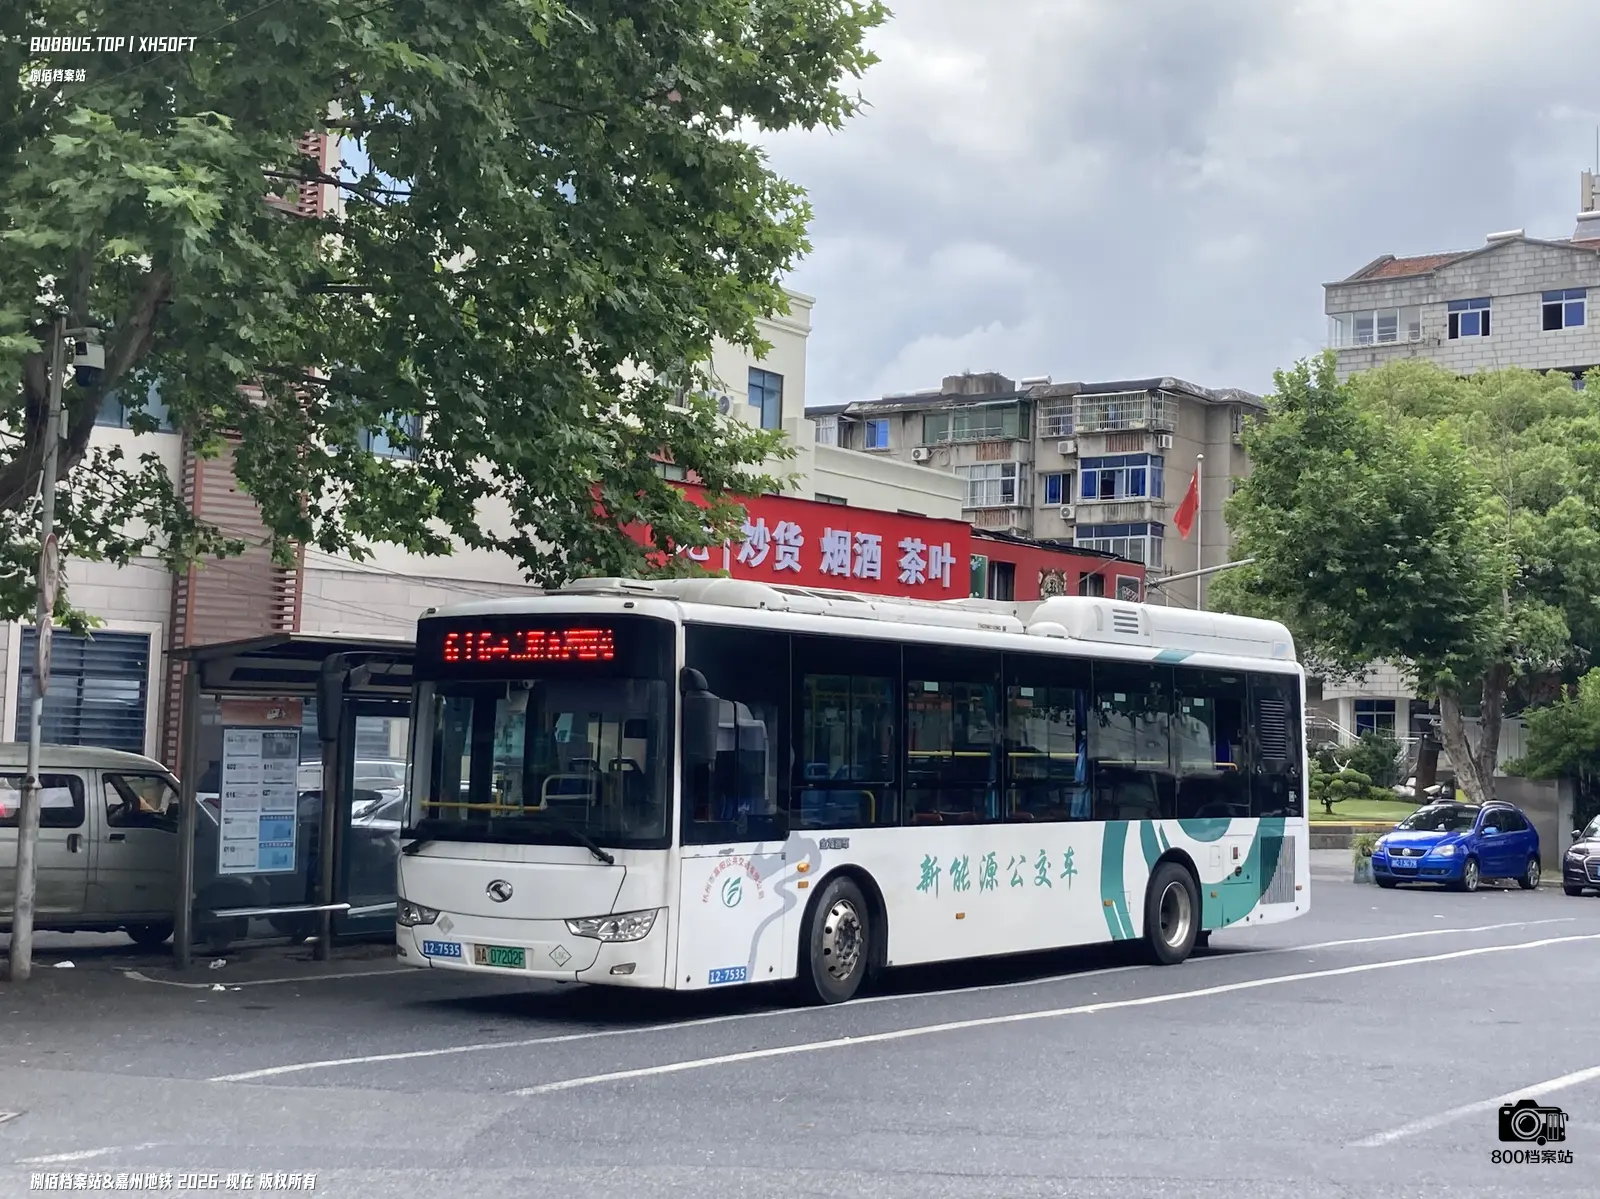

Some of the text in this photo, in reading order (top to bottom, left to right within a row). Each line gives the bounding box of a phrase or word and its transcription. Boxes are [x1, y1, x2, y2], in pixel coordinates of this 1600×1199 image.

[736, 516, 804, 573] 炒货
[818, 527, 883, 580] 烟酒
[896, 536, 957, 588] 茶叶
[916, 845, 1078, 899] 新能源公交车
[424, 942, 461, 956] 12-7535
[710, 968, 746, 983] 12-7535
